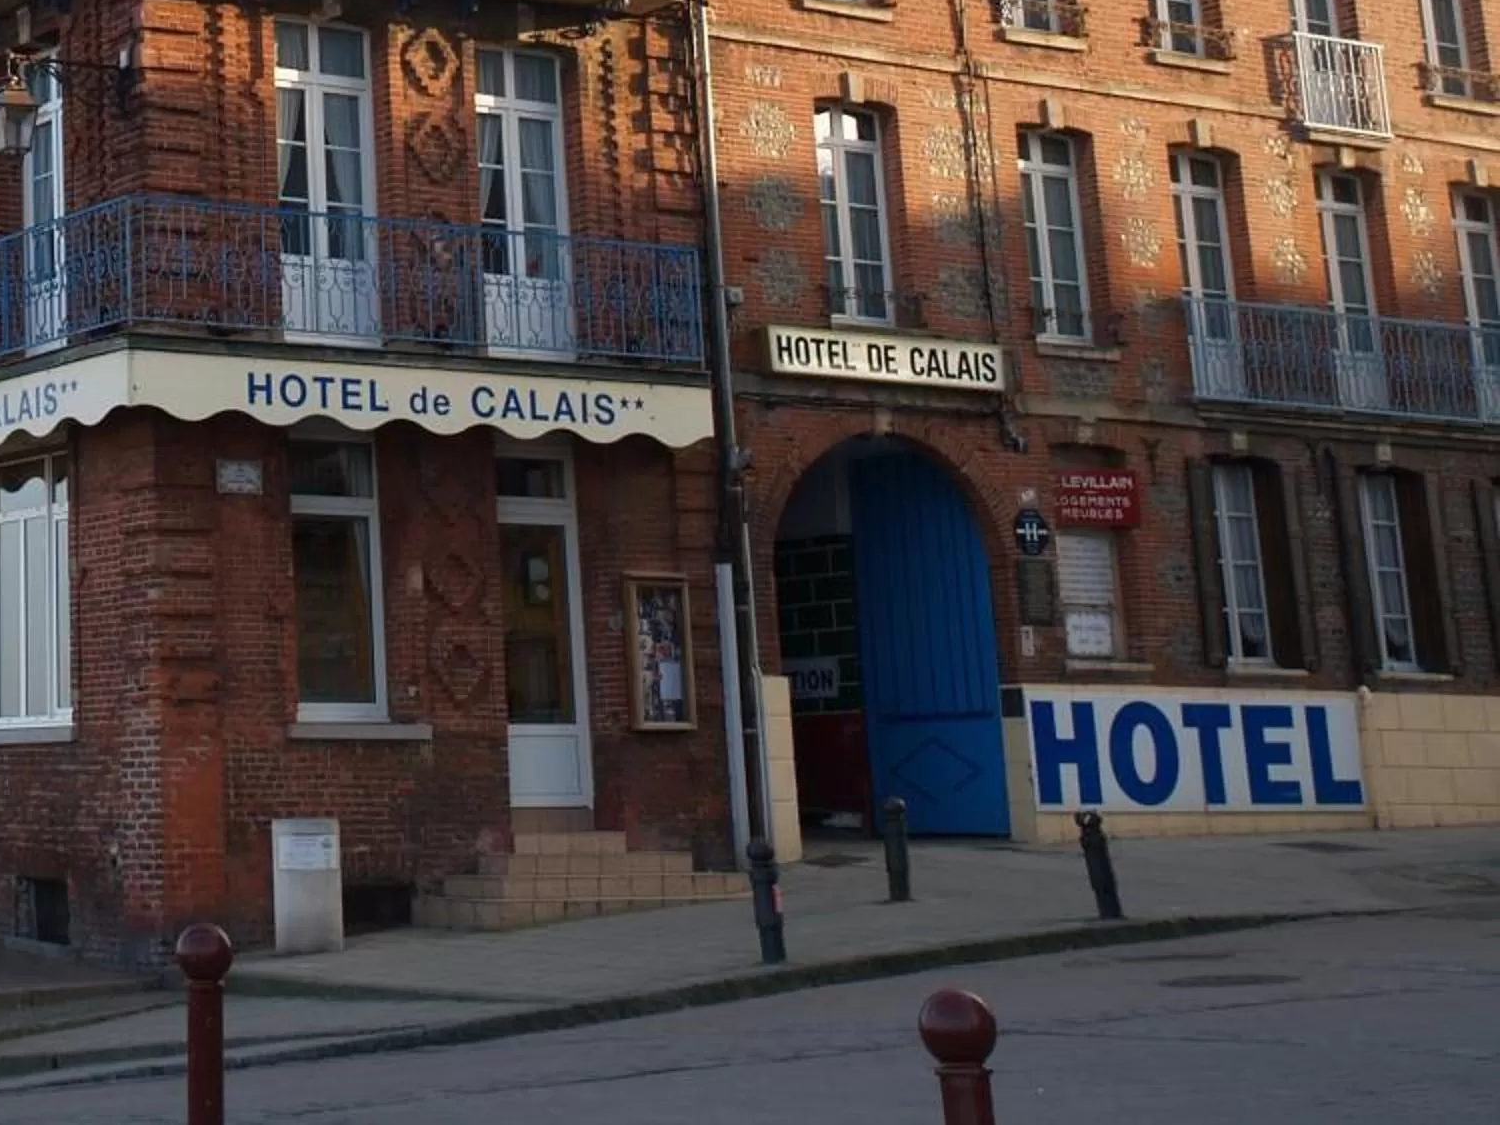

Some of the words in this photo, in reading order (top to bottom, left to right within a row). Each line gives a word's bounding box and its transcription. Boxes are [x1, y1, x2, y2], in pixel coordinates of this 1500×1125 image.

[776, 334, 857, 371] HOTEL
[867, 343, 899, 375] DE
[909, 346, 997, 383] CALAIS
[247, 371, 390, 413] HOTEL
[409, 386, 451, 416] de
[470, 385, 616, 425] CALAIS
[1061, 475, 1133, 490] LEVILLAIN
[792, 668, 834, 692] ION
[1029, 699, 1364, 807] HOTEL
